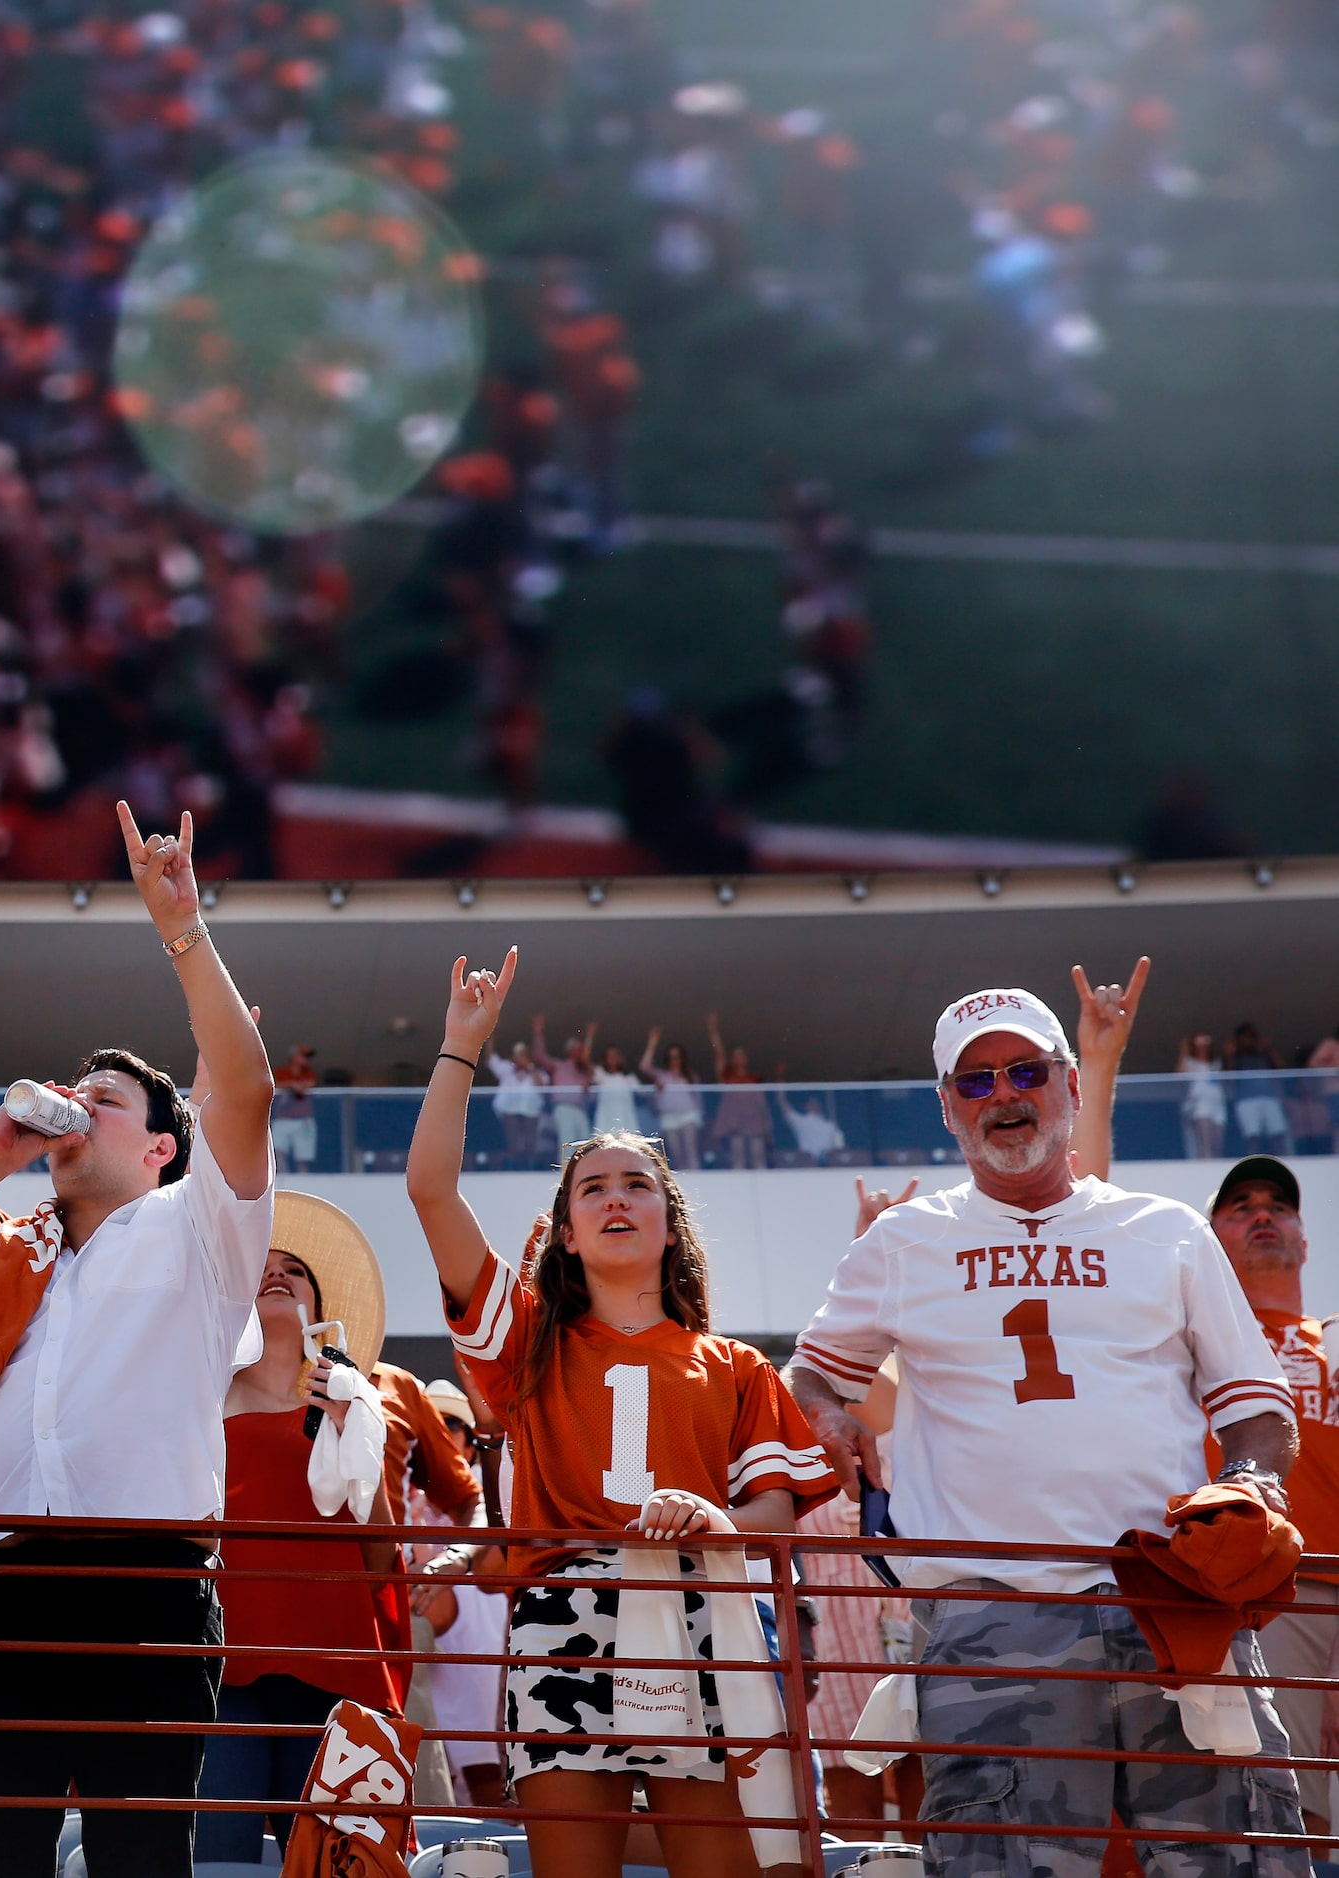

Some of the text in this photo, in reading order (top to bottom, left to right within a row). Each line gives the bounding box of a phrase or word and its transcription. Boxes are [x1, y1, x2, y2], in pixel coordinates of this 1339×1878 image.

[954, 993, 1022, 1024] TEXAS
[956, 1245, 1107, 1291] TEXAS
[1002, 1299, 1076, 1404] 1
[602, 1363, 655, 1506] 1
[655, 1704, 686, 1713] PROVIDER
